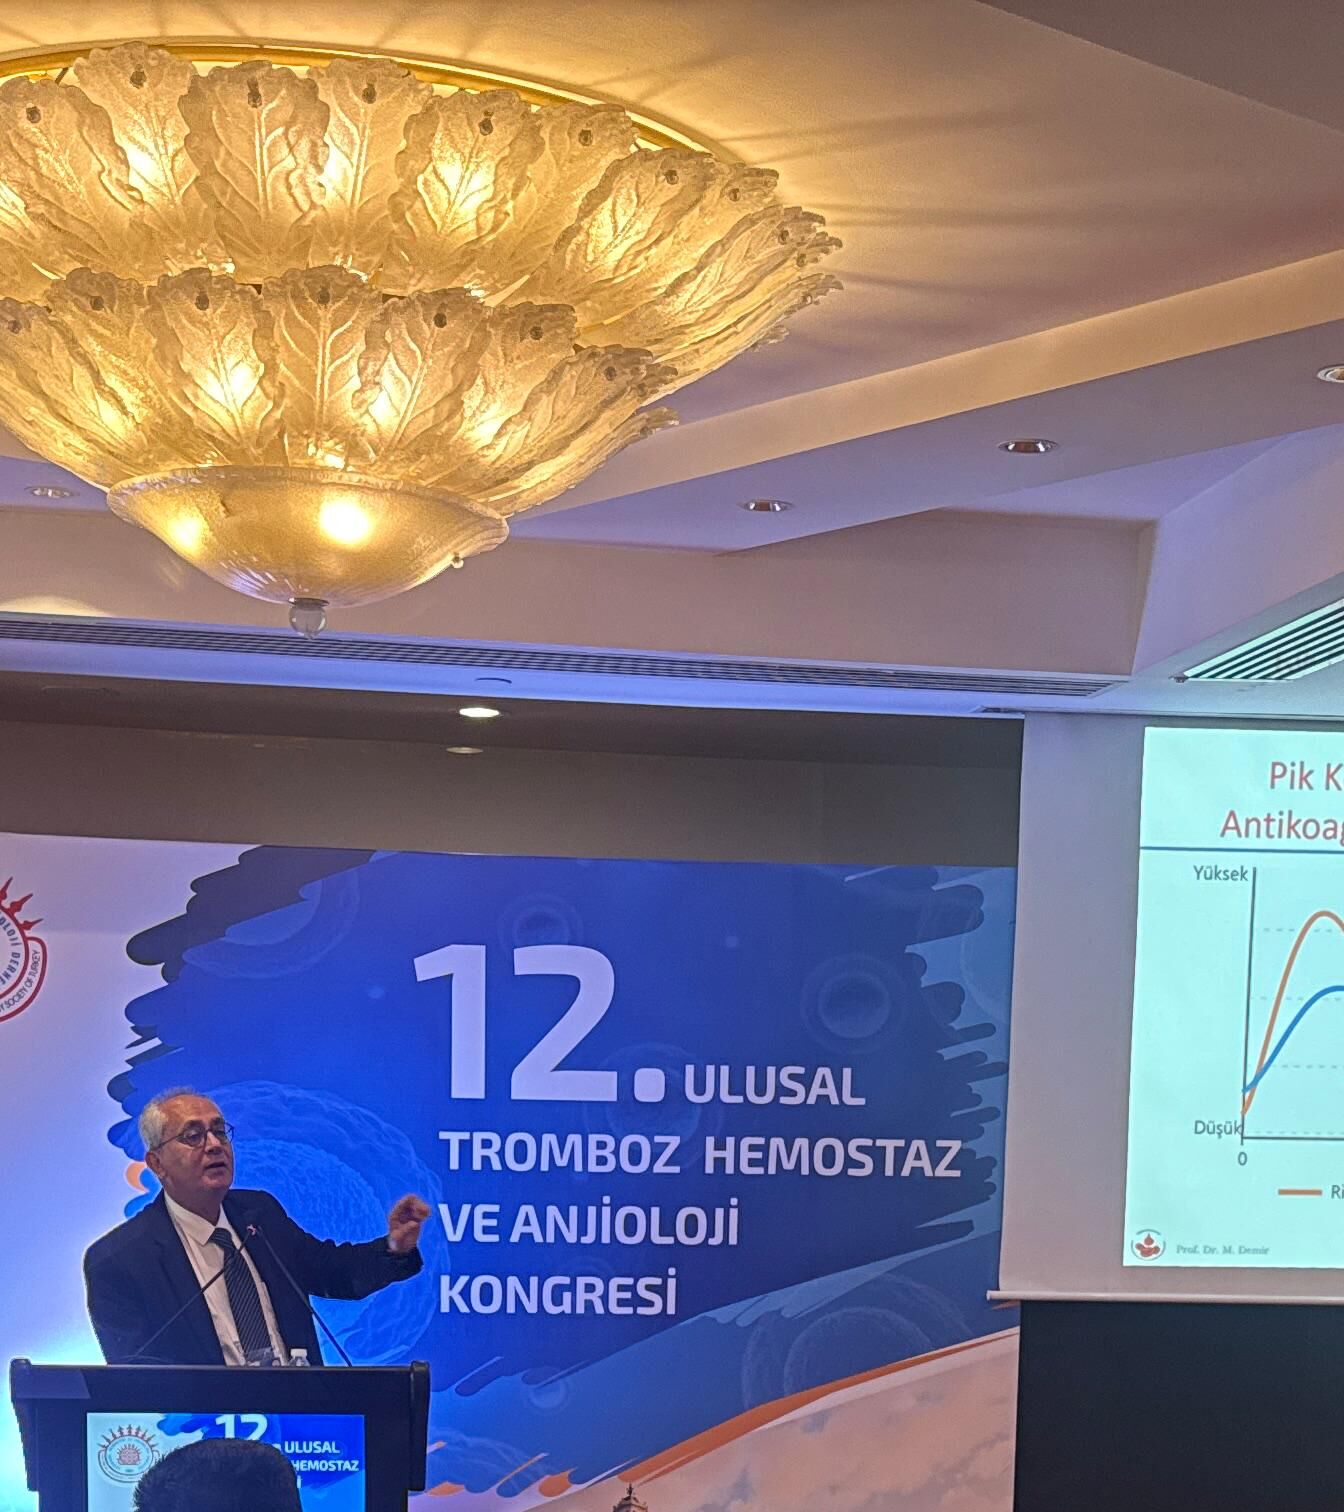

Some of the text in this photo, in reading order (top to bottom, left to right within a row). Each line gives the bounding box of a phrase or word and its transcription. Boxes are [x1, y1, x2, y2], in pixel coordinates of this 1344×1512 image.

[1269, 760, 1315, 791] Pik
[1193, 865, 1249, 881] Yüksek
[413, 944, 866, 1106] 12. ULUSAL
[1194, 1119, 1242, 1139] Düşük
[438, 1131, 962, 1178] TROMBOZ HEMOSTAZ
[1237, 1151, 1248, 1166] 0
[438, 1195, 739, 1246] VE ANJİOLOJİ
[439, 1267, 677, 1316] KONGRESİ
[284, 1441, 340, 1454] ULUSAL
